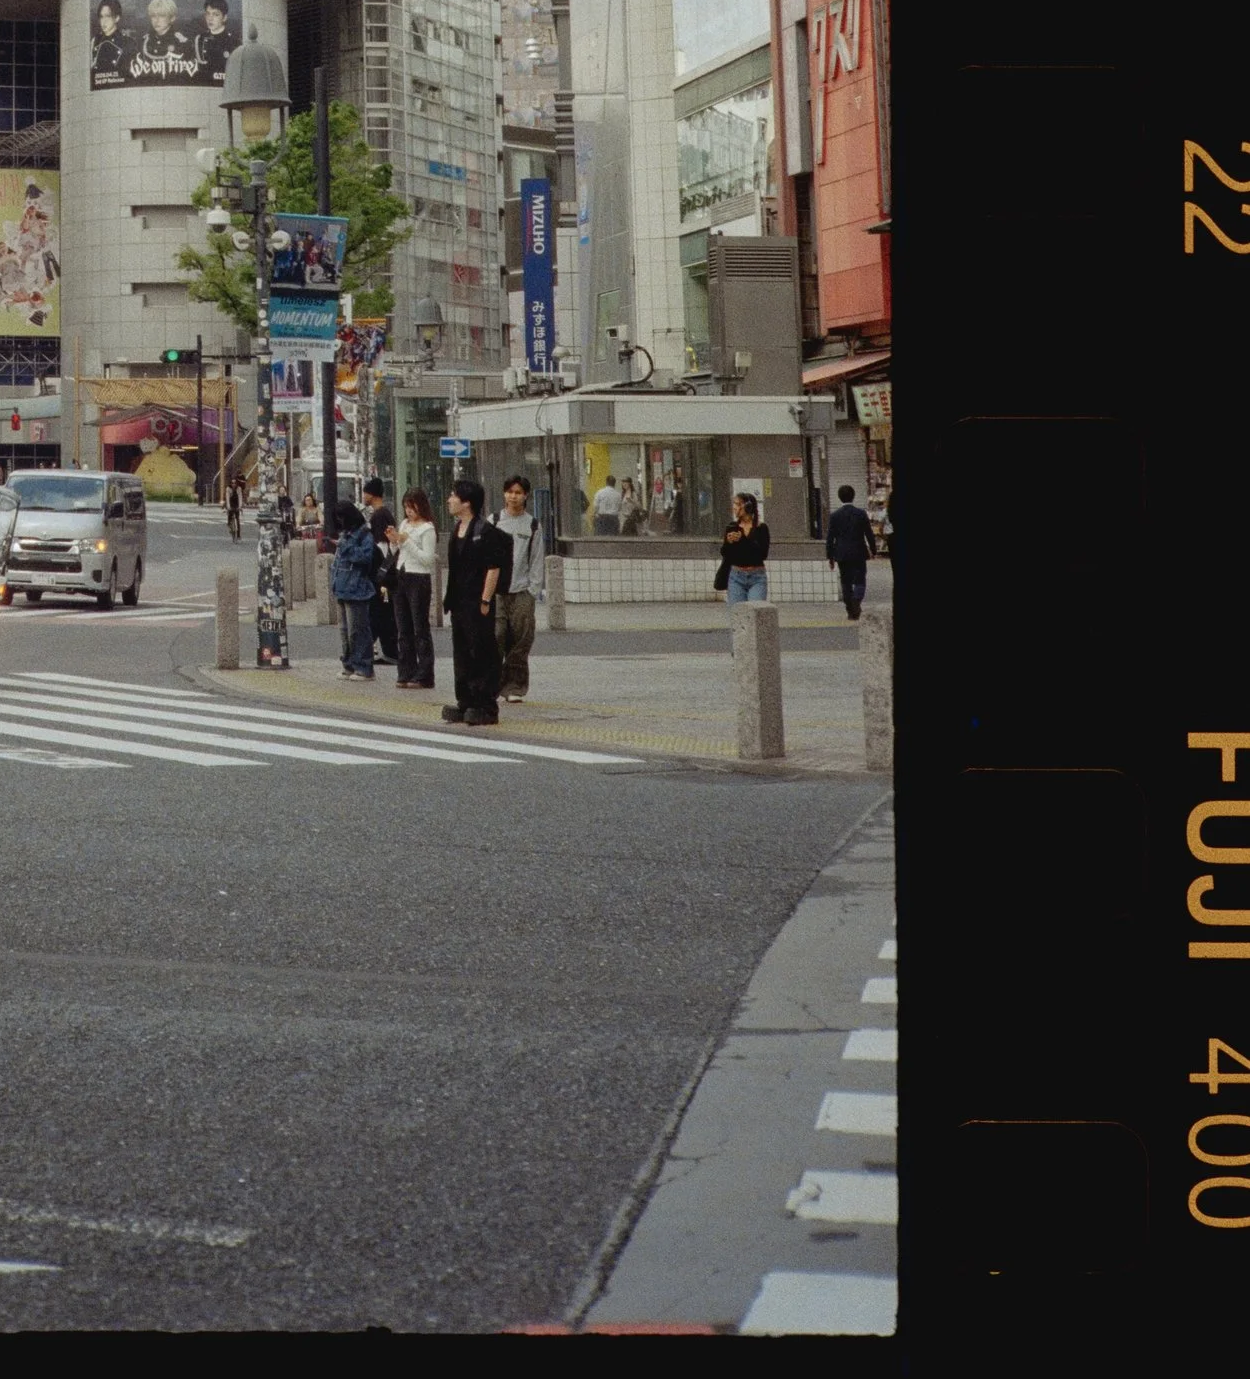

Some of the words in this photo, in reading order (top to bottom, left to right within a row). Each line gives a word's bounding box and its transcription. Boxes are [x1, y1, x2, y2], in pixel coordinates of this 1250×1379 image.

[130, 52, 151, 79] We
[532, 194, 545, 255] MIZUHO
[271, 309, 334, 328] MOMENTUM
[532, 300, 546, 366] みずほ銀行
[1186, 731, 1250, 959] FUJI
[1187, 1037, 1250, 1229] 400
